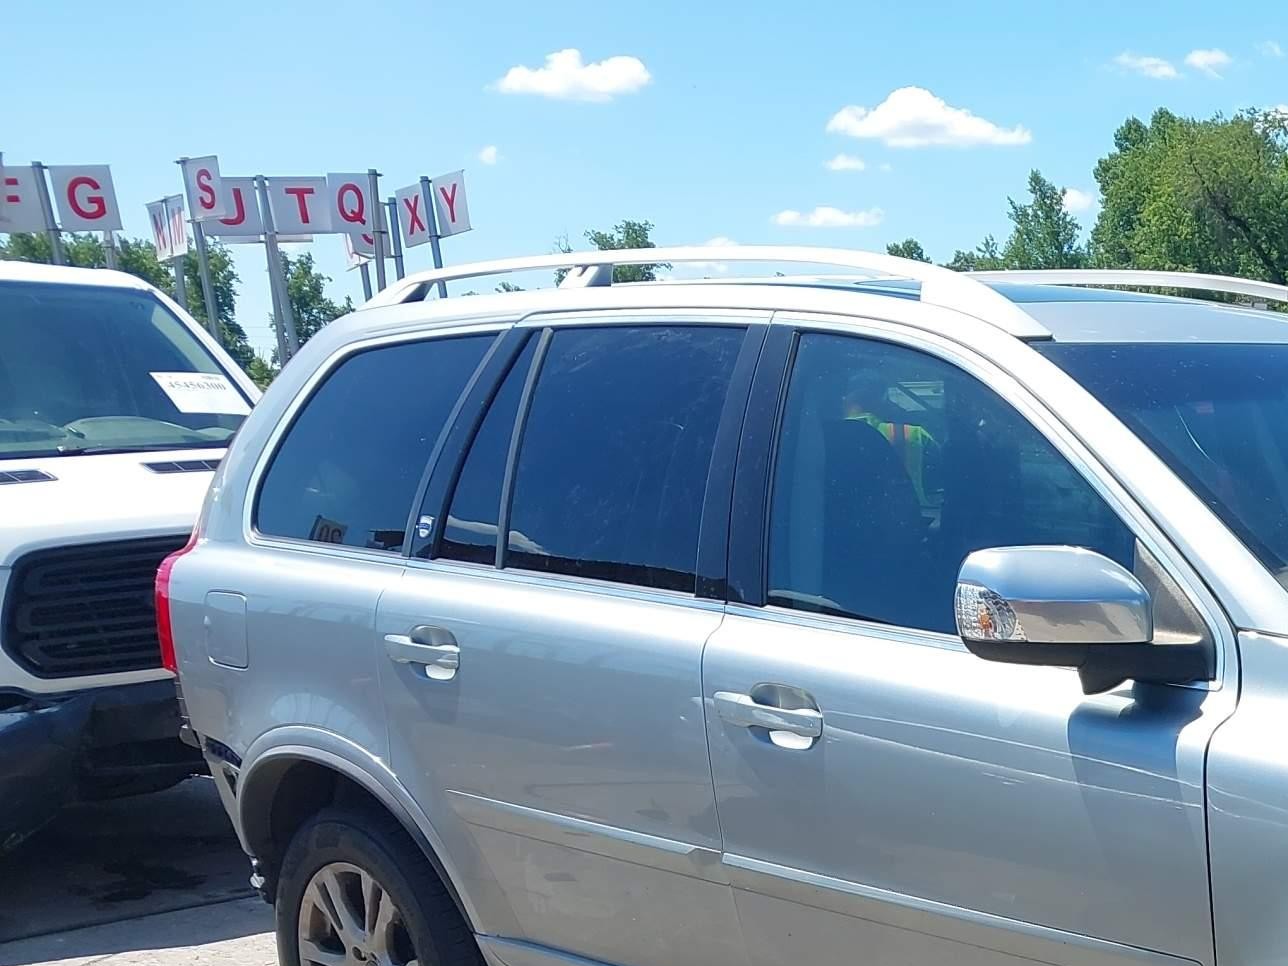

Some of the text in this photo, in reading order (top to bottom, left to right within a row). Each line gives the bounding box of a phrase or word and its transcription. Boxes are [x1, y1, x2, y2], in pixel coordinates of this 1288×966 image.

[67, 176, 107, 220] G
[197, 168, 216, 210] S
[284, 187, 314, 224] T
[338, 183, 366, 225] Q
[440, 183, 457, 223] Y
[403, 194, 426, 235] X
